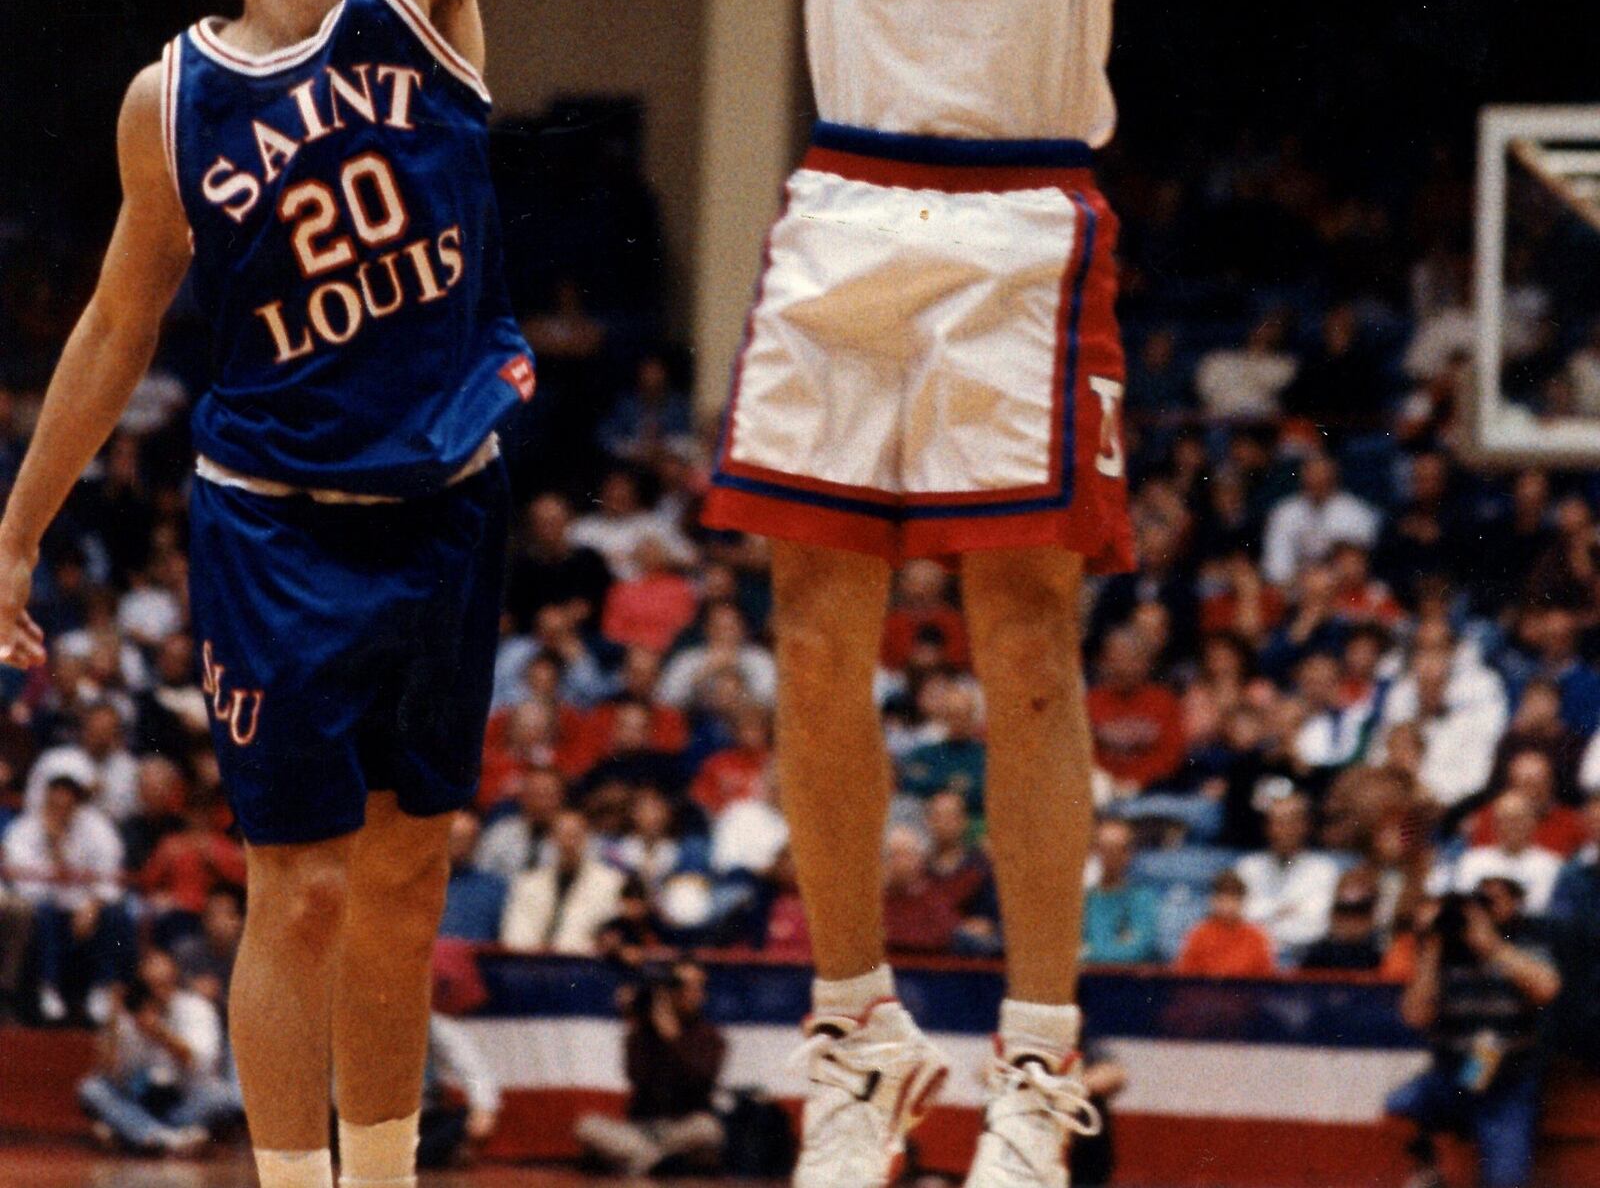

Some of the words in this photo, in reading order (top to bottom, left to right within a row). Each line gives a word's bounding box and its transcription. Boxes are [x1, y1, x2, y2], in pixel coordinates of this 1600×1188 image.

[202, 63, 423, 224] SAINT
[277, 150, 409, 279] 20
[255, 224, 465, 364] LOUIS
